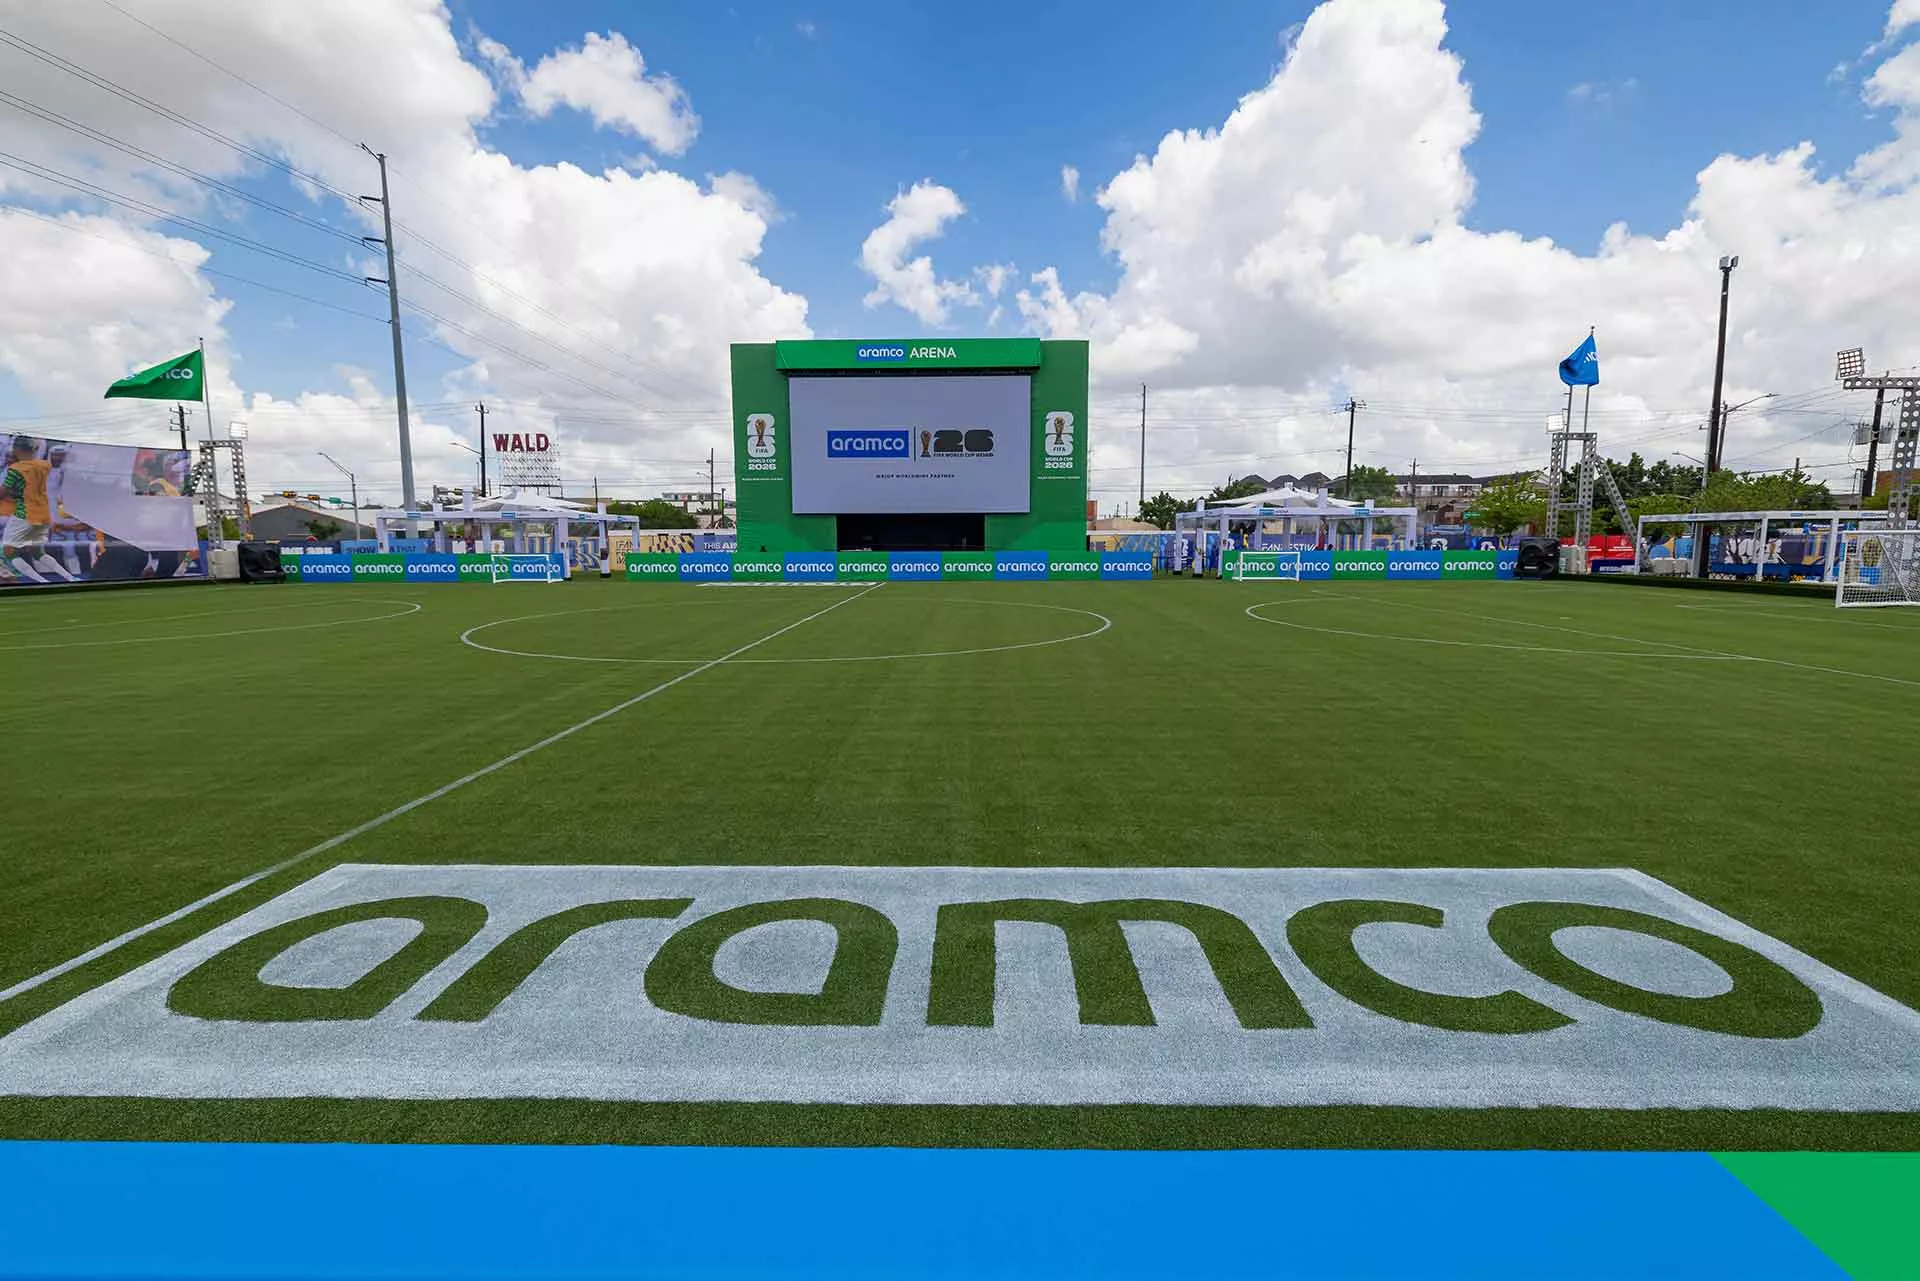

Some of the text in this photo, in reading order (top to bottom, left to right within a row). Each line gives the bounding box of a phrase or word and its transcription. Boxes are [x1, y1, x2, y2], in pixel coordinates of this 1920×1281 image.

[858, 347, 957, 359] aramco ARENA
[493, 433, 549, 452] WALD
[831, 438, 905, 451] aramco
[1045, 461, 1073, 469] 2026
[302, 564, 351, 574] aramco
[354, 564, 404, 574] aramco
[407, 564, 456, 573] aramco
[629, 562, 1152, 573] aramco aramco aramco aramco aramco aramco aramco aramco aramco aramco
[1334, 561, 1385, 571] aramco
[1389, 561, 1440, 571] aramco
[1444, 561, 1495, 571] aramco
[166, 895, 1824, 1039] aramco
